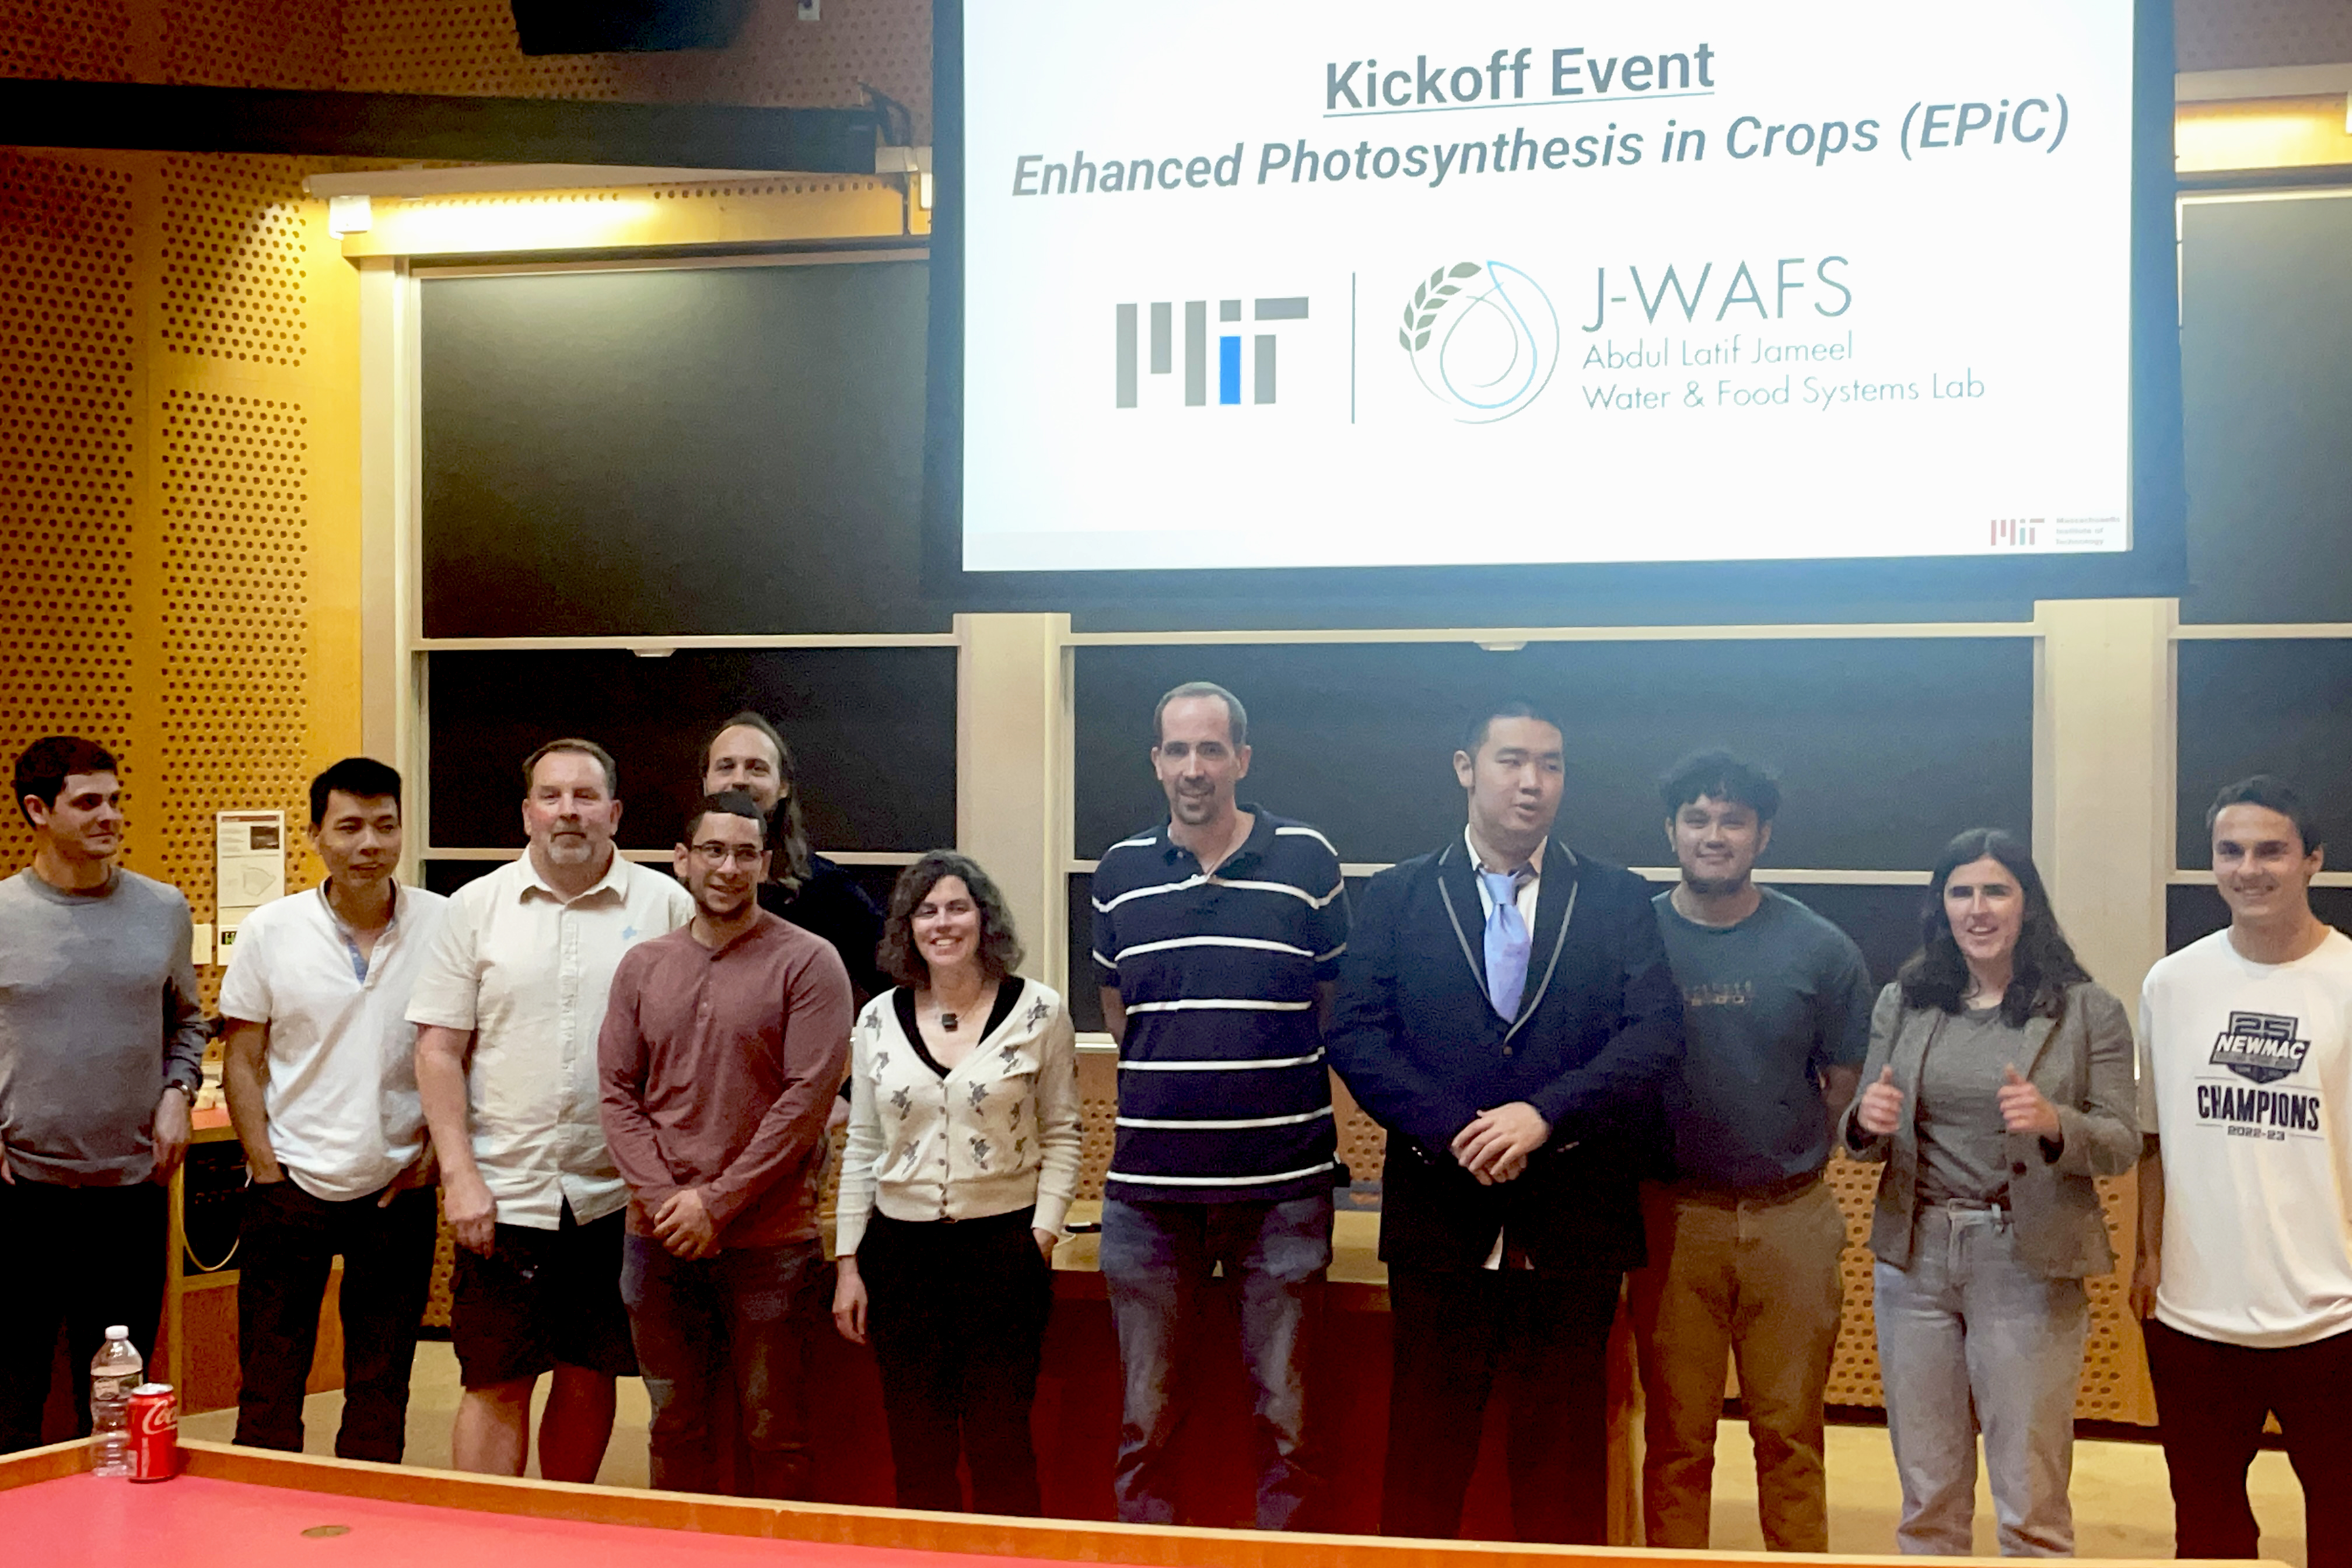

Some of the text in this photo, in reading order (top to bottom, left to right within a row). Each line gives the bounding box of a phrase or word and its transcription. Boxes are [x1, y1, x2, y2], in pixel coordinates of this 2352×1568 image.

[1326, 43, 1715, 110] Kickoff Event
[1012, 93, 2068, 197] Enhanced Photosynthesis in Crops (EPiC)
[1581, 256, 1852, 334] J-WAFS
[1581, 329, 1853, 370] Abdul Latif Jameel
[1581, 367, 1985, 412] Water & Food Systems Lab
[2216, 1034, 2306, 1059] NEWMAC
[2234, 1017, 2291, 1040] 25
[2197, 1084, 2320, 1132] CHAMPIONS
[2228, 1125, 2285, 1140] 2022-23
